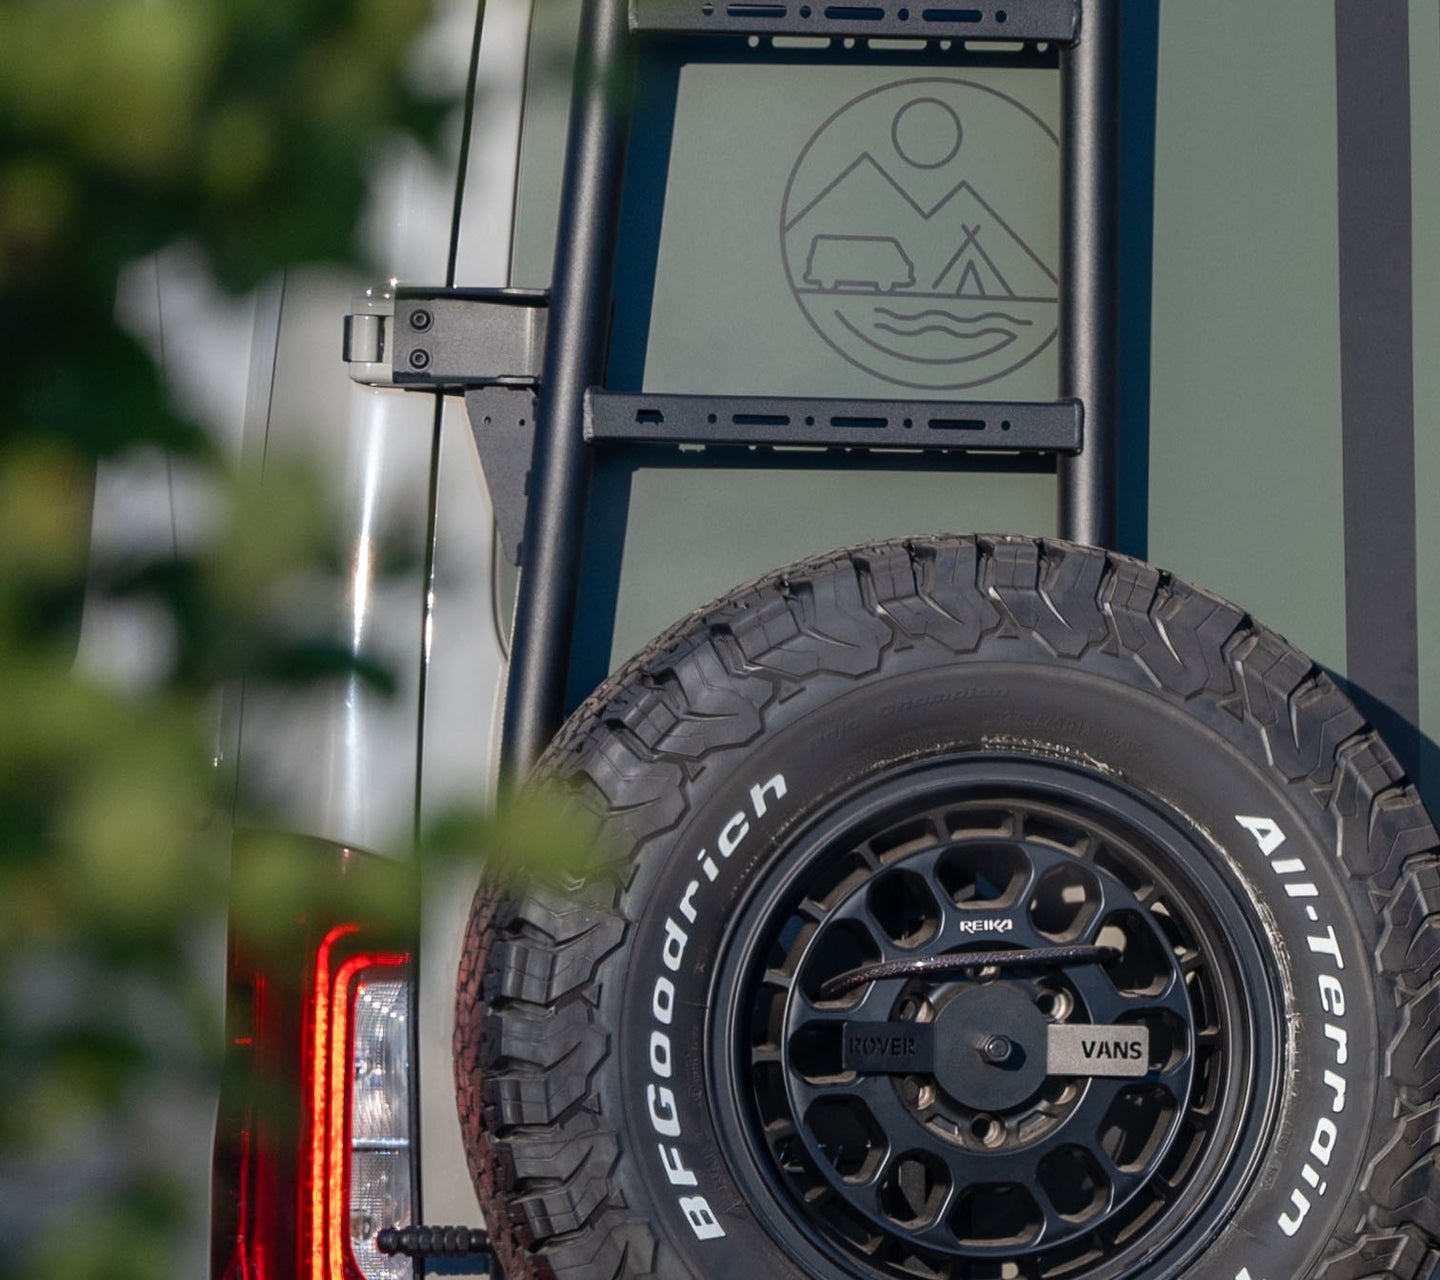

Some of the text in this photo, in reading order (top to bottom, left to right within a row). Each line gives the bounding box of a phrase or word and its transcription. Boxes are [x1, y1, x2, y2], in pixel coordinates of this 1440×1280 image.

[647, 773, 787, 1240] BFGoodrich
[959, 918, 1013, 934] REIKA
[1234, 814, 1348, 1238] All-Terrain
[849, 1036, 1143, 1060] ROVER VANS
